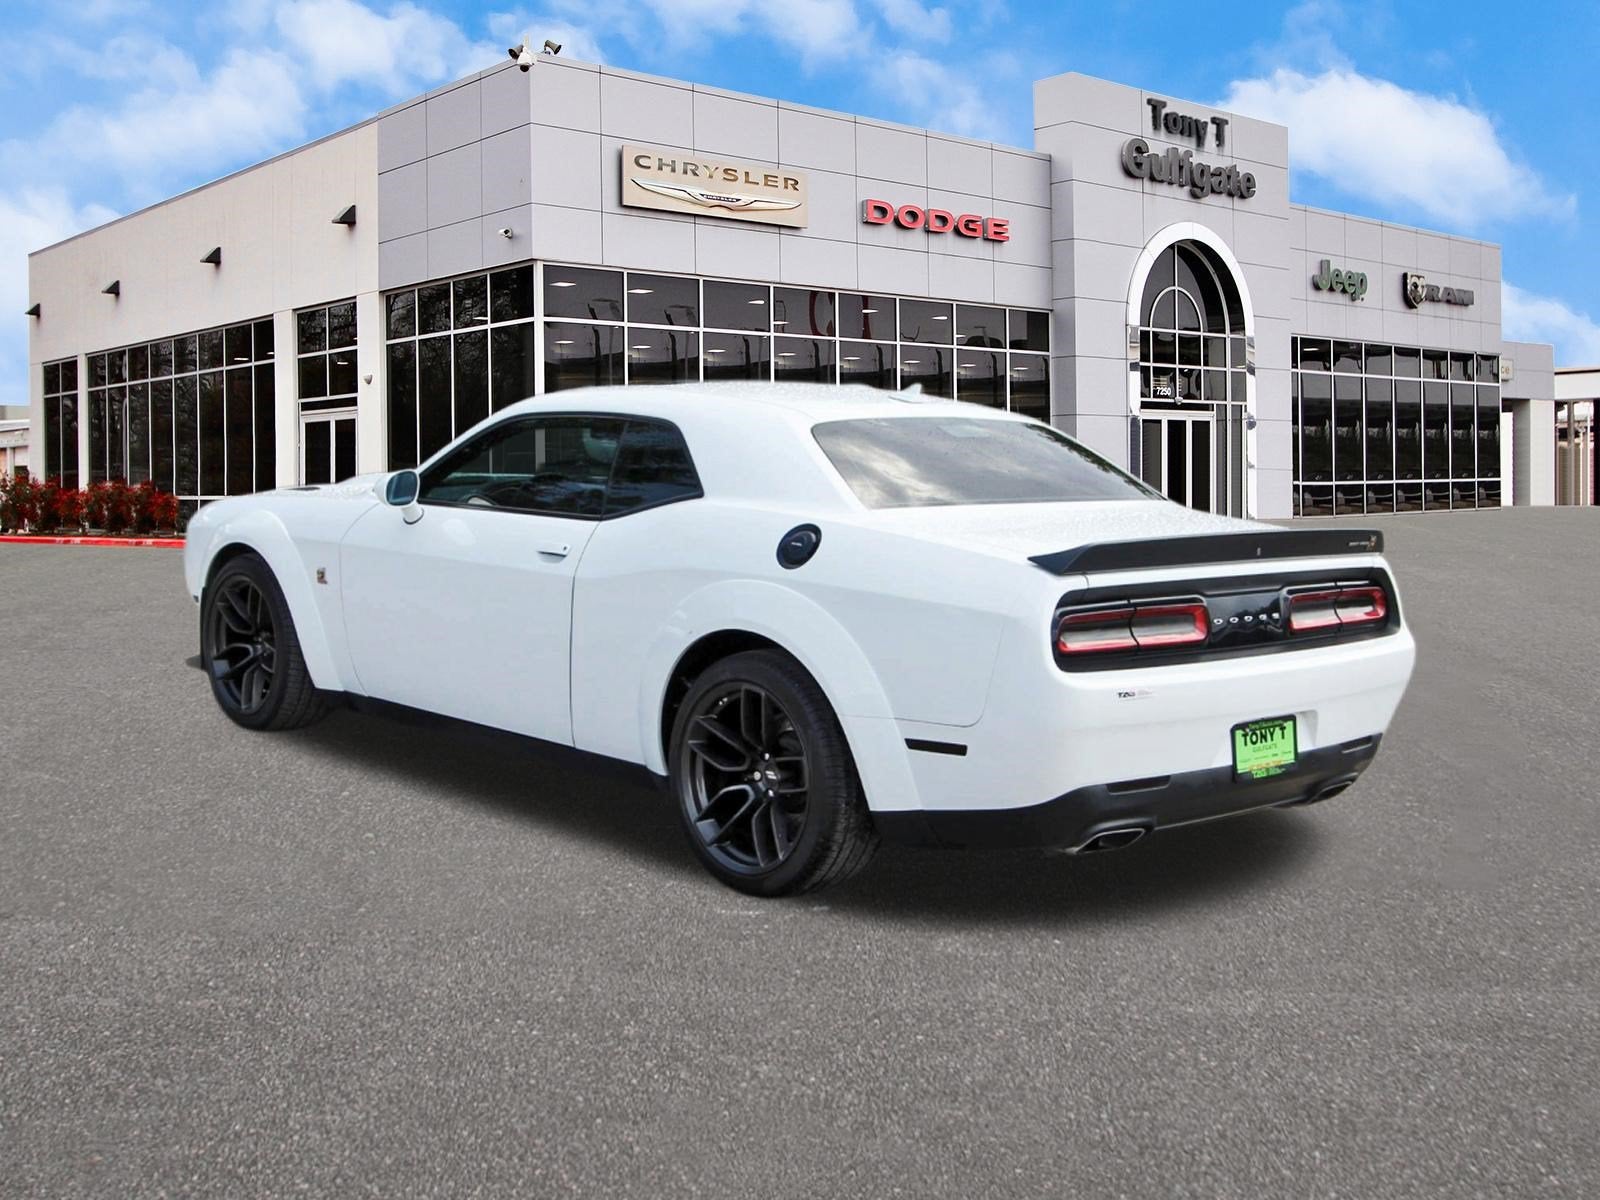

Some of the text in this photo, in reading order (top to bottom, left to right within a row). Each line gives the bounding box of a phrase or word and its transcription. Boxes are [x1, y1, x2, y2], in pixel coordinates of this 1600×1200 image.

[1147, 98, 1229, 148] Tony T
[633, 154, 800, 192] CHRYSLER
[1121, 138, 1257, 199] Gulfgate
[862, 199, 1010, 242] DODGE
[1312, 259, 1368, 302] Jeep
[1424, 284, 1475, 306] RAM
[1156, 387, 1171, 395] 7250
[1241, 727, 1276, 747] TONY
[1279, 725, 1287, 740] T
